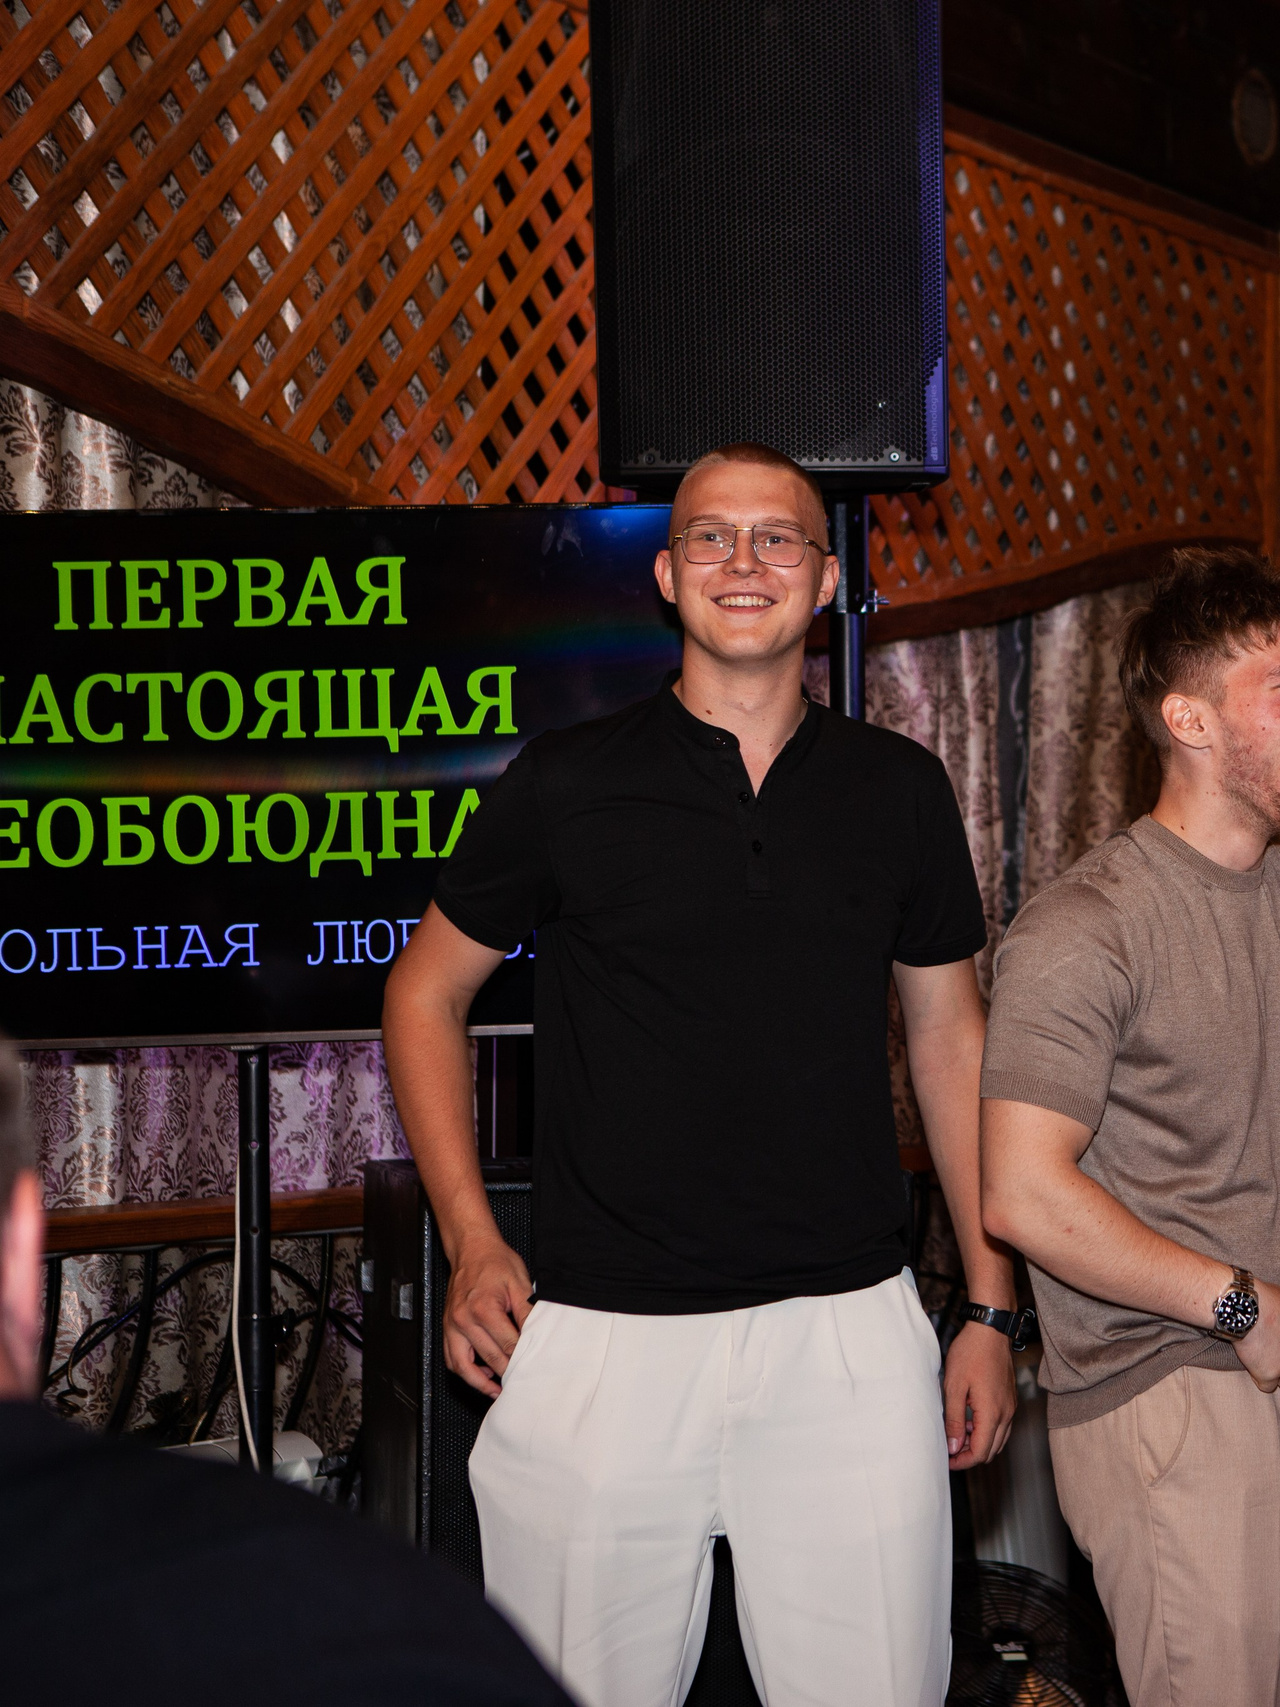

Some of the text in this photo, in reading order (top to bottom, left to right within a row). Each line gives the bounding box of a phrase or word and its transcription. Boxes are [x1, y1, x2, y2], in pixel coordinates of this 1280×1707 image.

[52, 556, 408, 630] ПЕРВАЯ
[0, 666, 518, 753] АСТОЯЩАЯ
[0, 923, 260, 974] ОЛЬНАЯ
